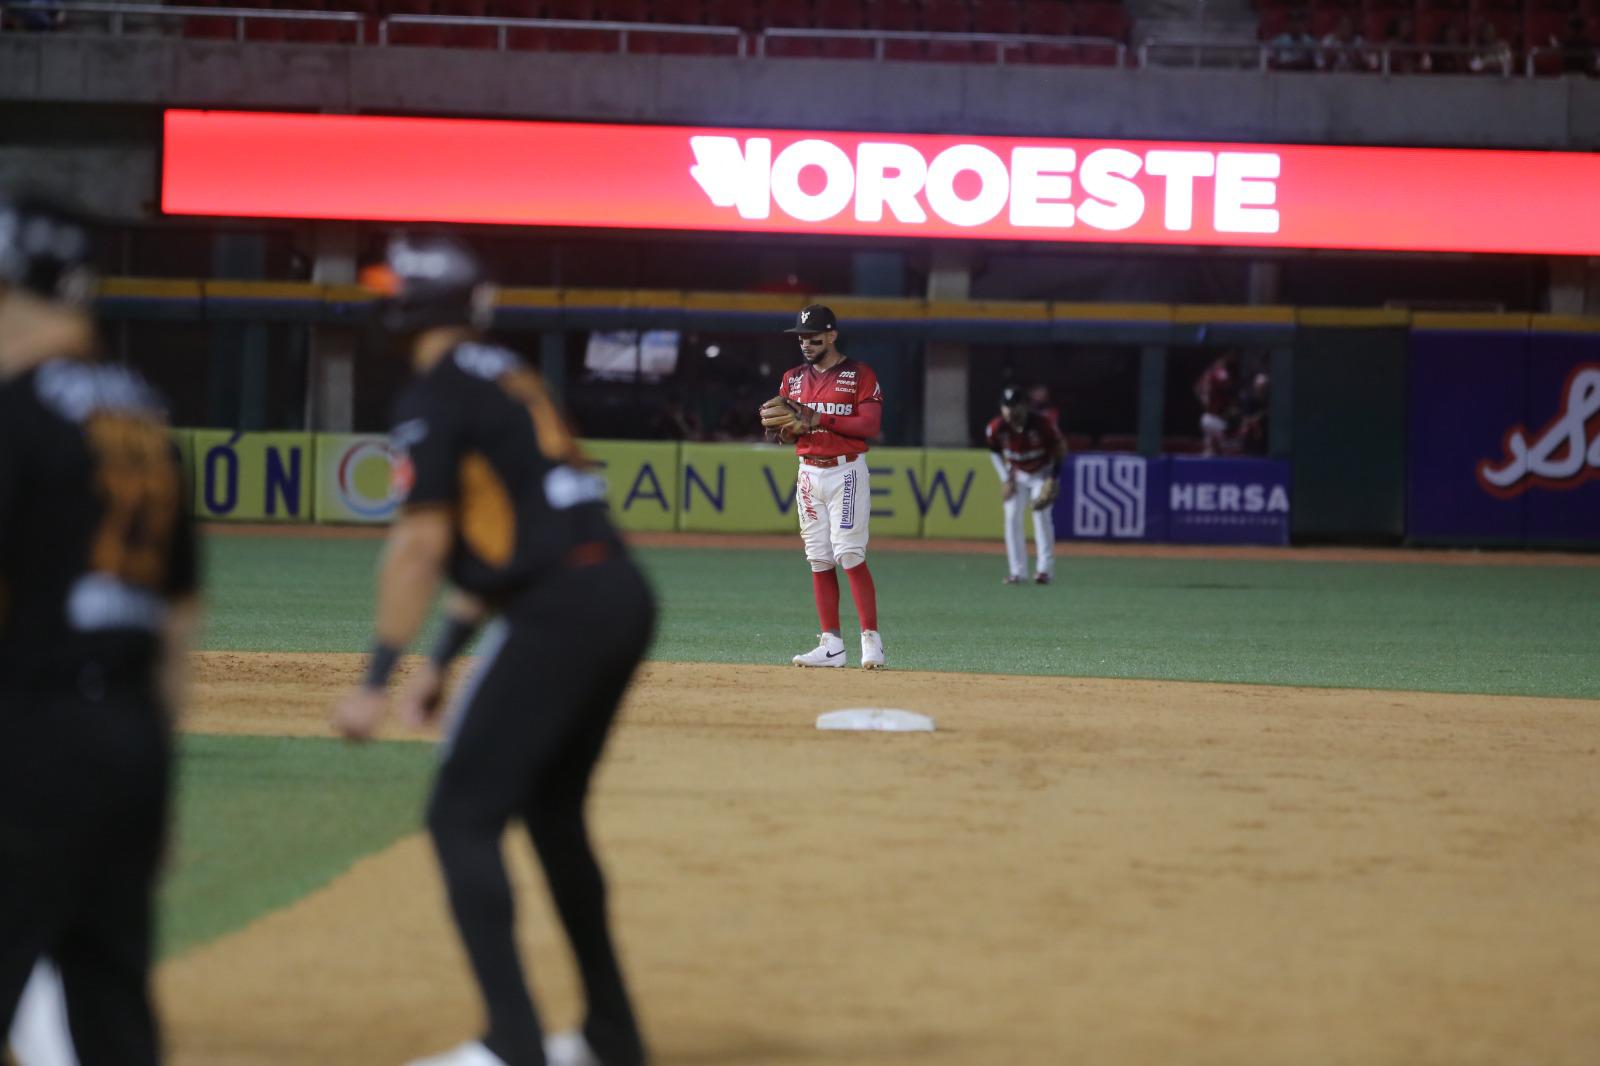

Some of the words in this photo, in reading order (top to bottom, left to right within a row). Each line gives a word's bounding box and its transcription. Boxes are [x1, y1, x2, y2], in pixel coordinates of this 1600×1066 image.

[690, 135, 1281, 234] NOROESTE
[176, 431, 302, 518] ÓN
[603, 463, 726, 513] AN
[762, 464, 975, 519] VEW
[841, 473, 852, 523] PAQUETEXPRESS
[1169, 482, 1290, 513] HERSA
